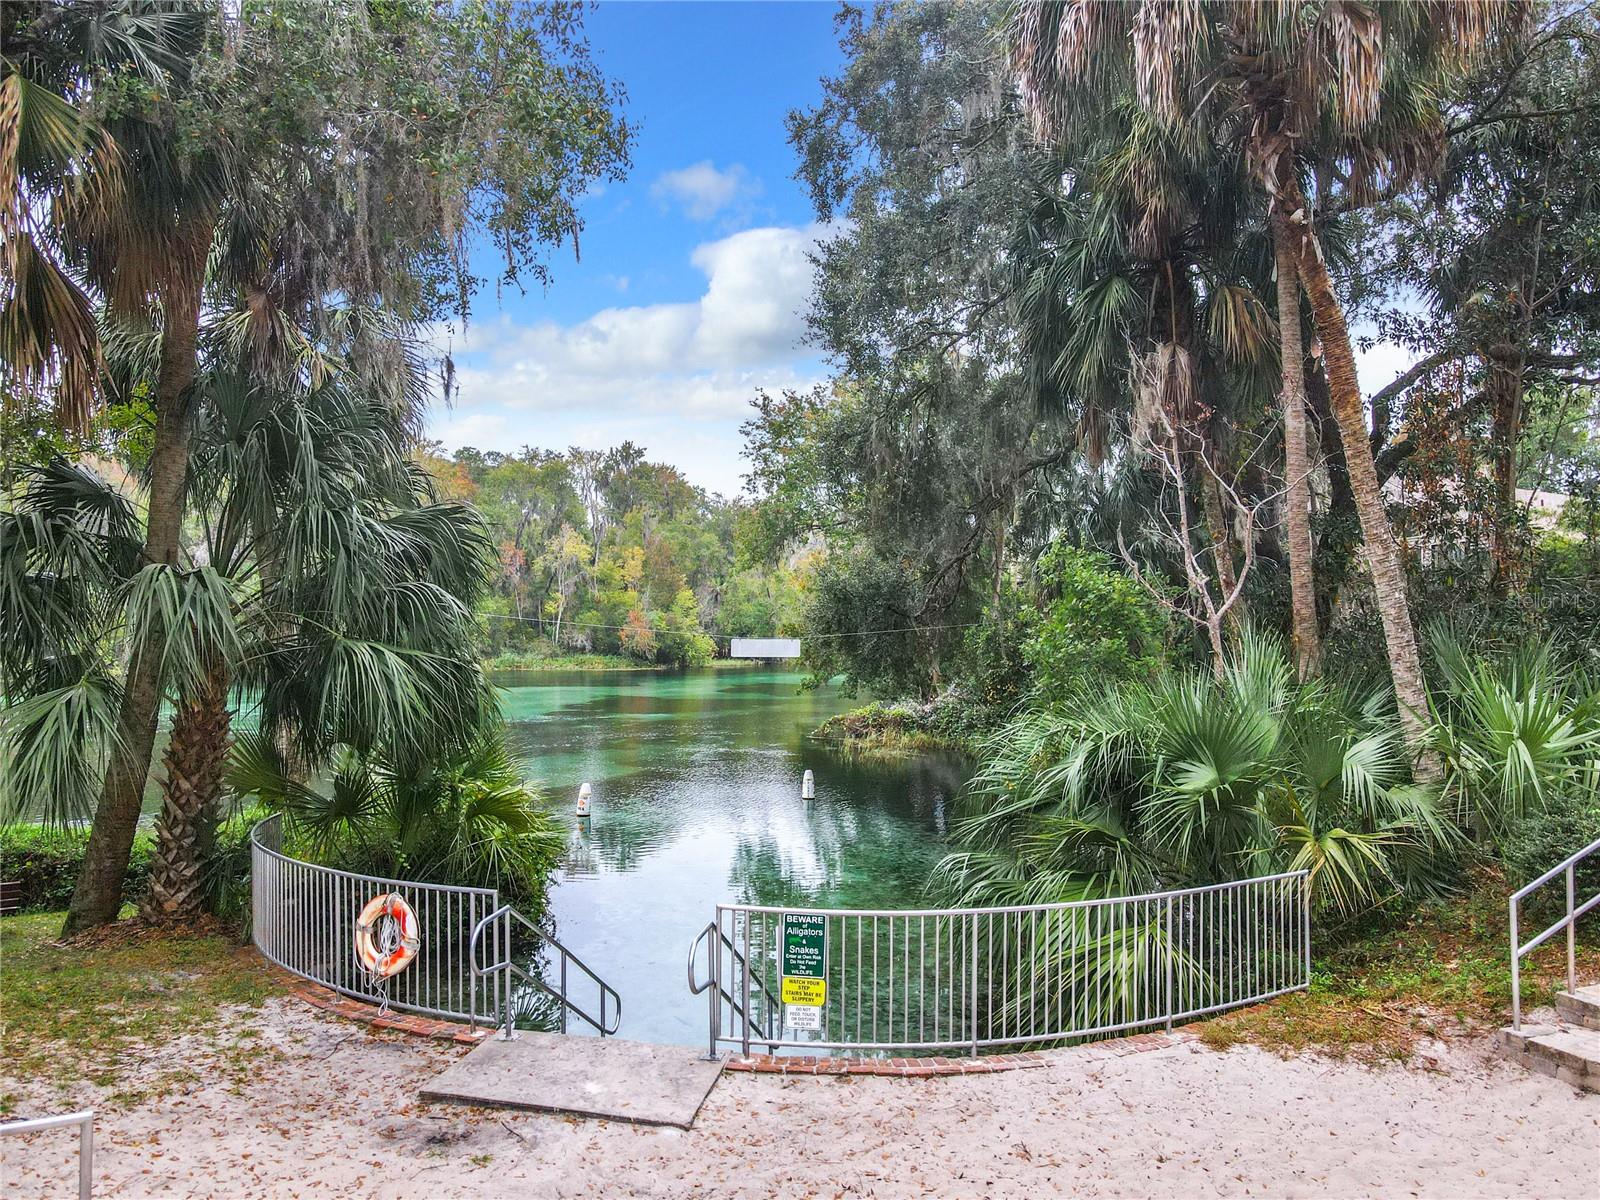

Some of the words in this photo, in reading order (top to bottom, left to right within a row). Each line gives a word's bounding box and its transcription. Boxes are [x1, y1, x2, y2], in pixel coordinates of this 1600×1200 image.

[787, 915, 823, 924] BEWARE
[786, 927, 823, 936] Alligators
[789, 945, 818, 954] Snakes
